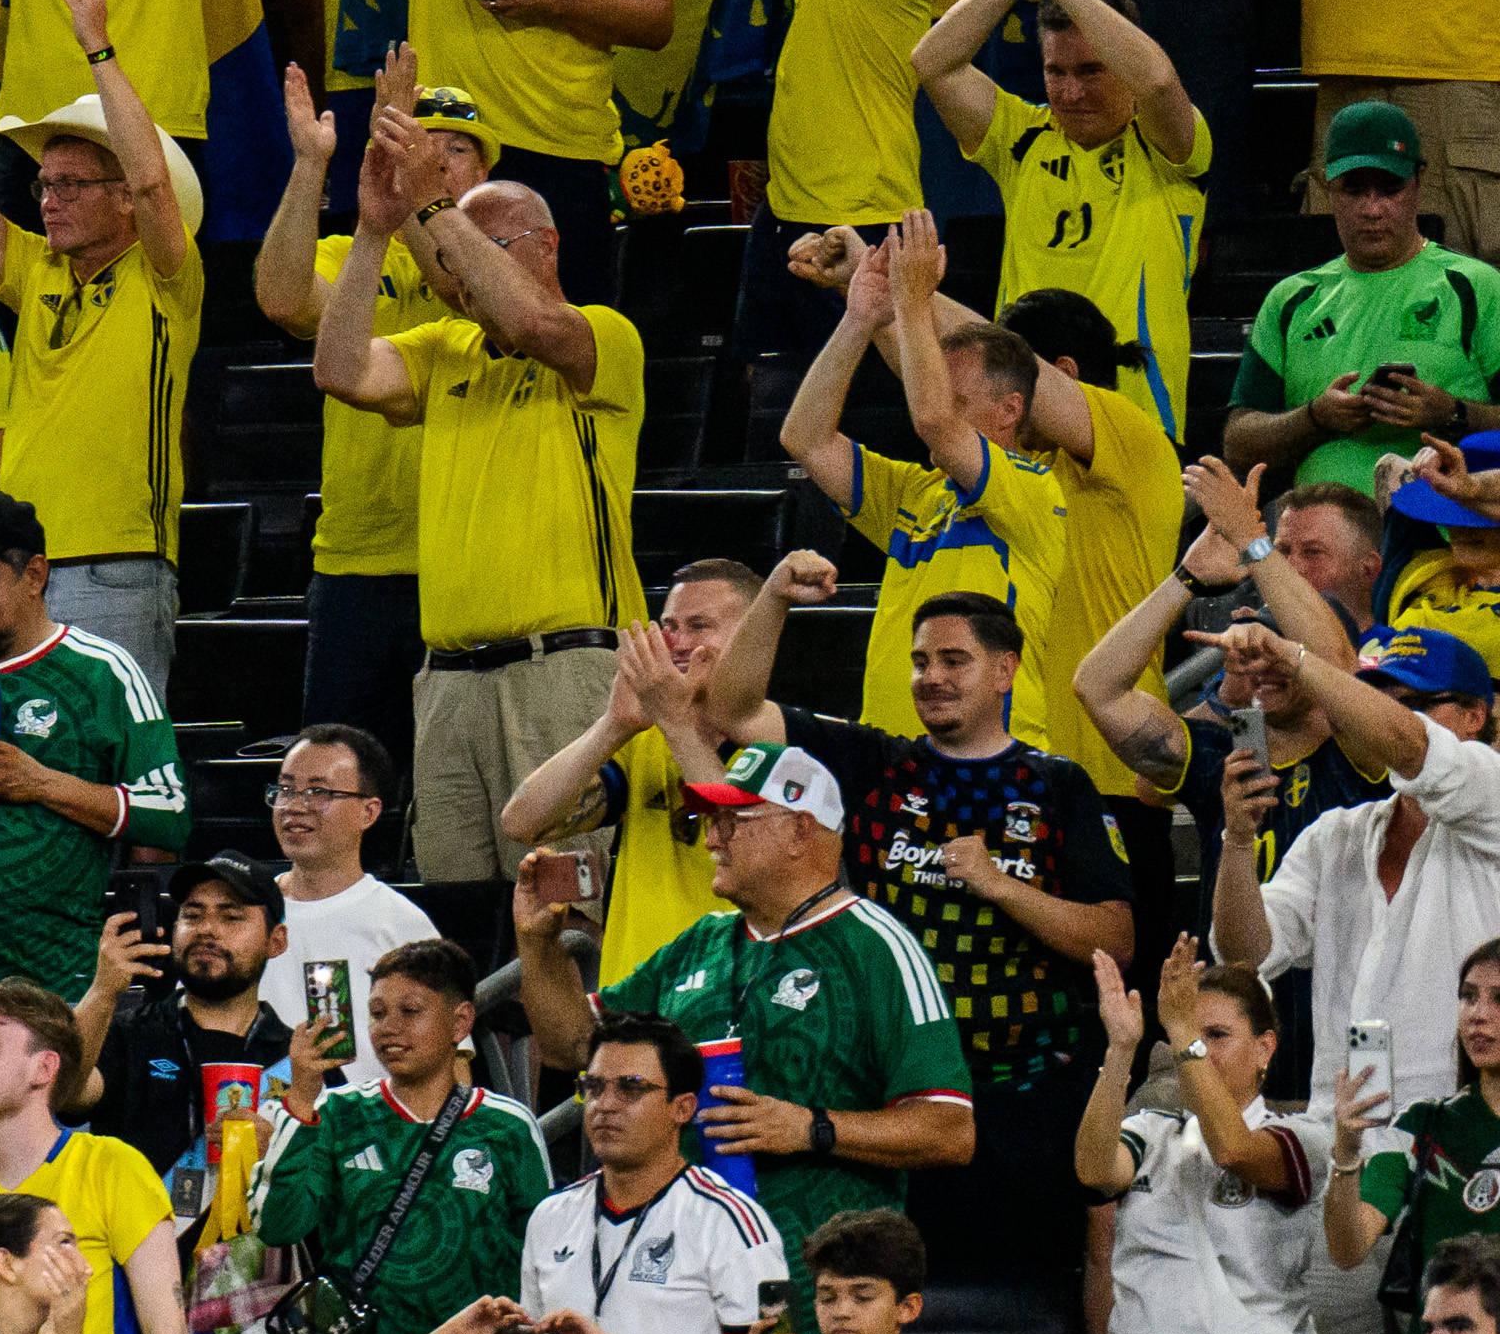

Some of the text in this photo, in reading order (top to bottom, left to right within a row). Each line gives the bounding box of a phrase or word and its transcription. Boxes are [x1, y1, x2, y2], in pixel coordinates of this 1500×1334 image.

[885, 838, 1037, 880] Boylorts
[912, 870, 947, 886] THIS
[430, 1094, 465, 1143] UNDER
